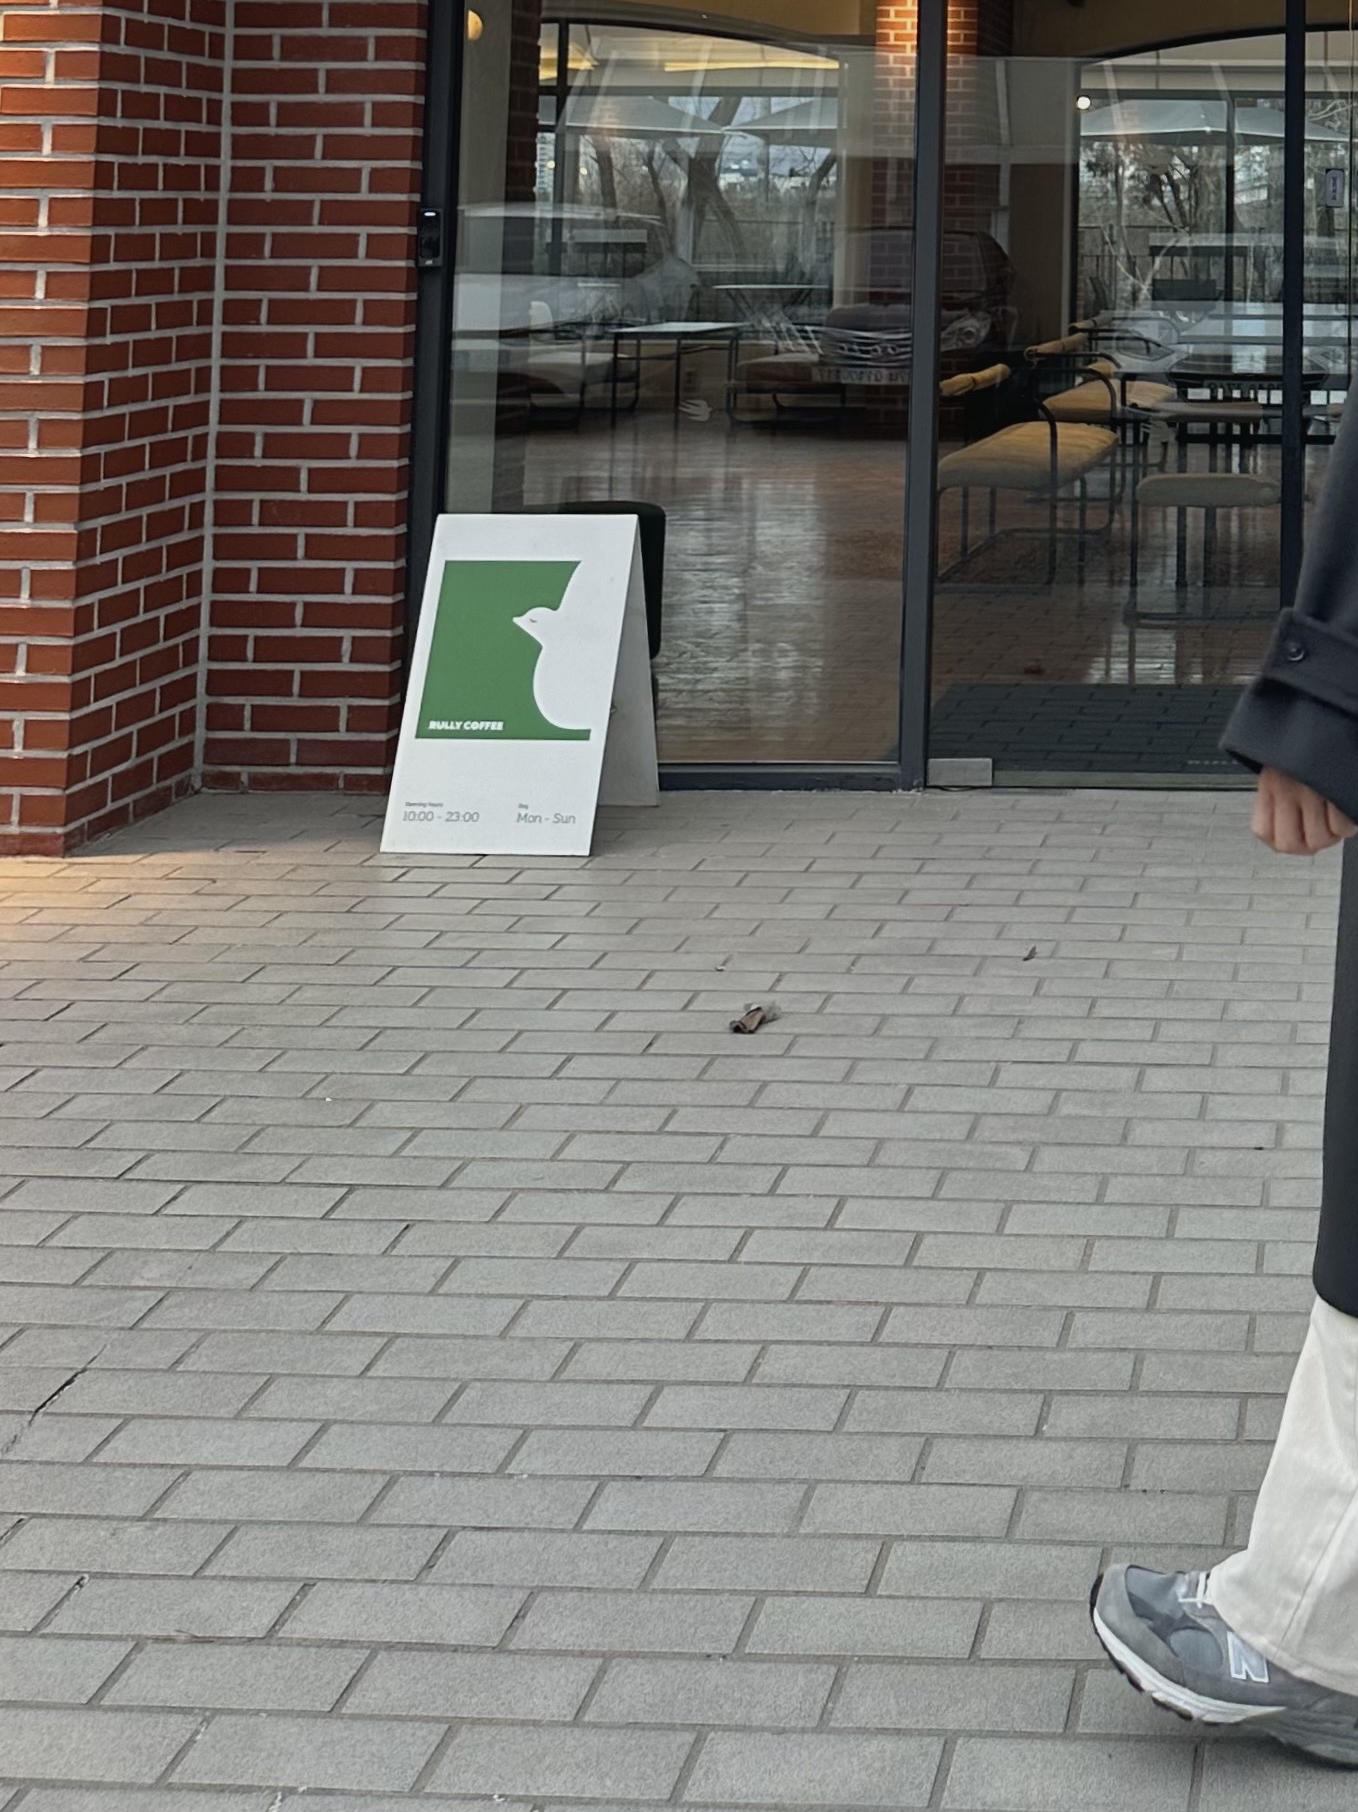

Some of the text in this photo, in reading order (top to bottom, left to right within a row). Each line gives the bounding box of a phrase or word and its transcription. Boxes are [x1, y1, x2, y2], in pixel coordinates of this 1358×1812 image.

[428, 720, 504, 730] RULLY COFFEE
[402, 811, 434, 822] 10:00
[445, 811, 480, 823] 23:00
[516, 813, 542, 824] Mon
[552, 813, 576, 824] Sun
[1226, 1631, 1270, 1683] N
